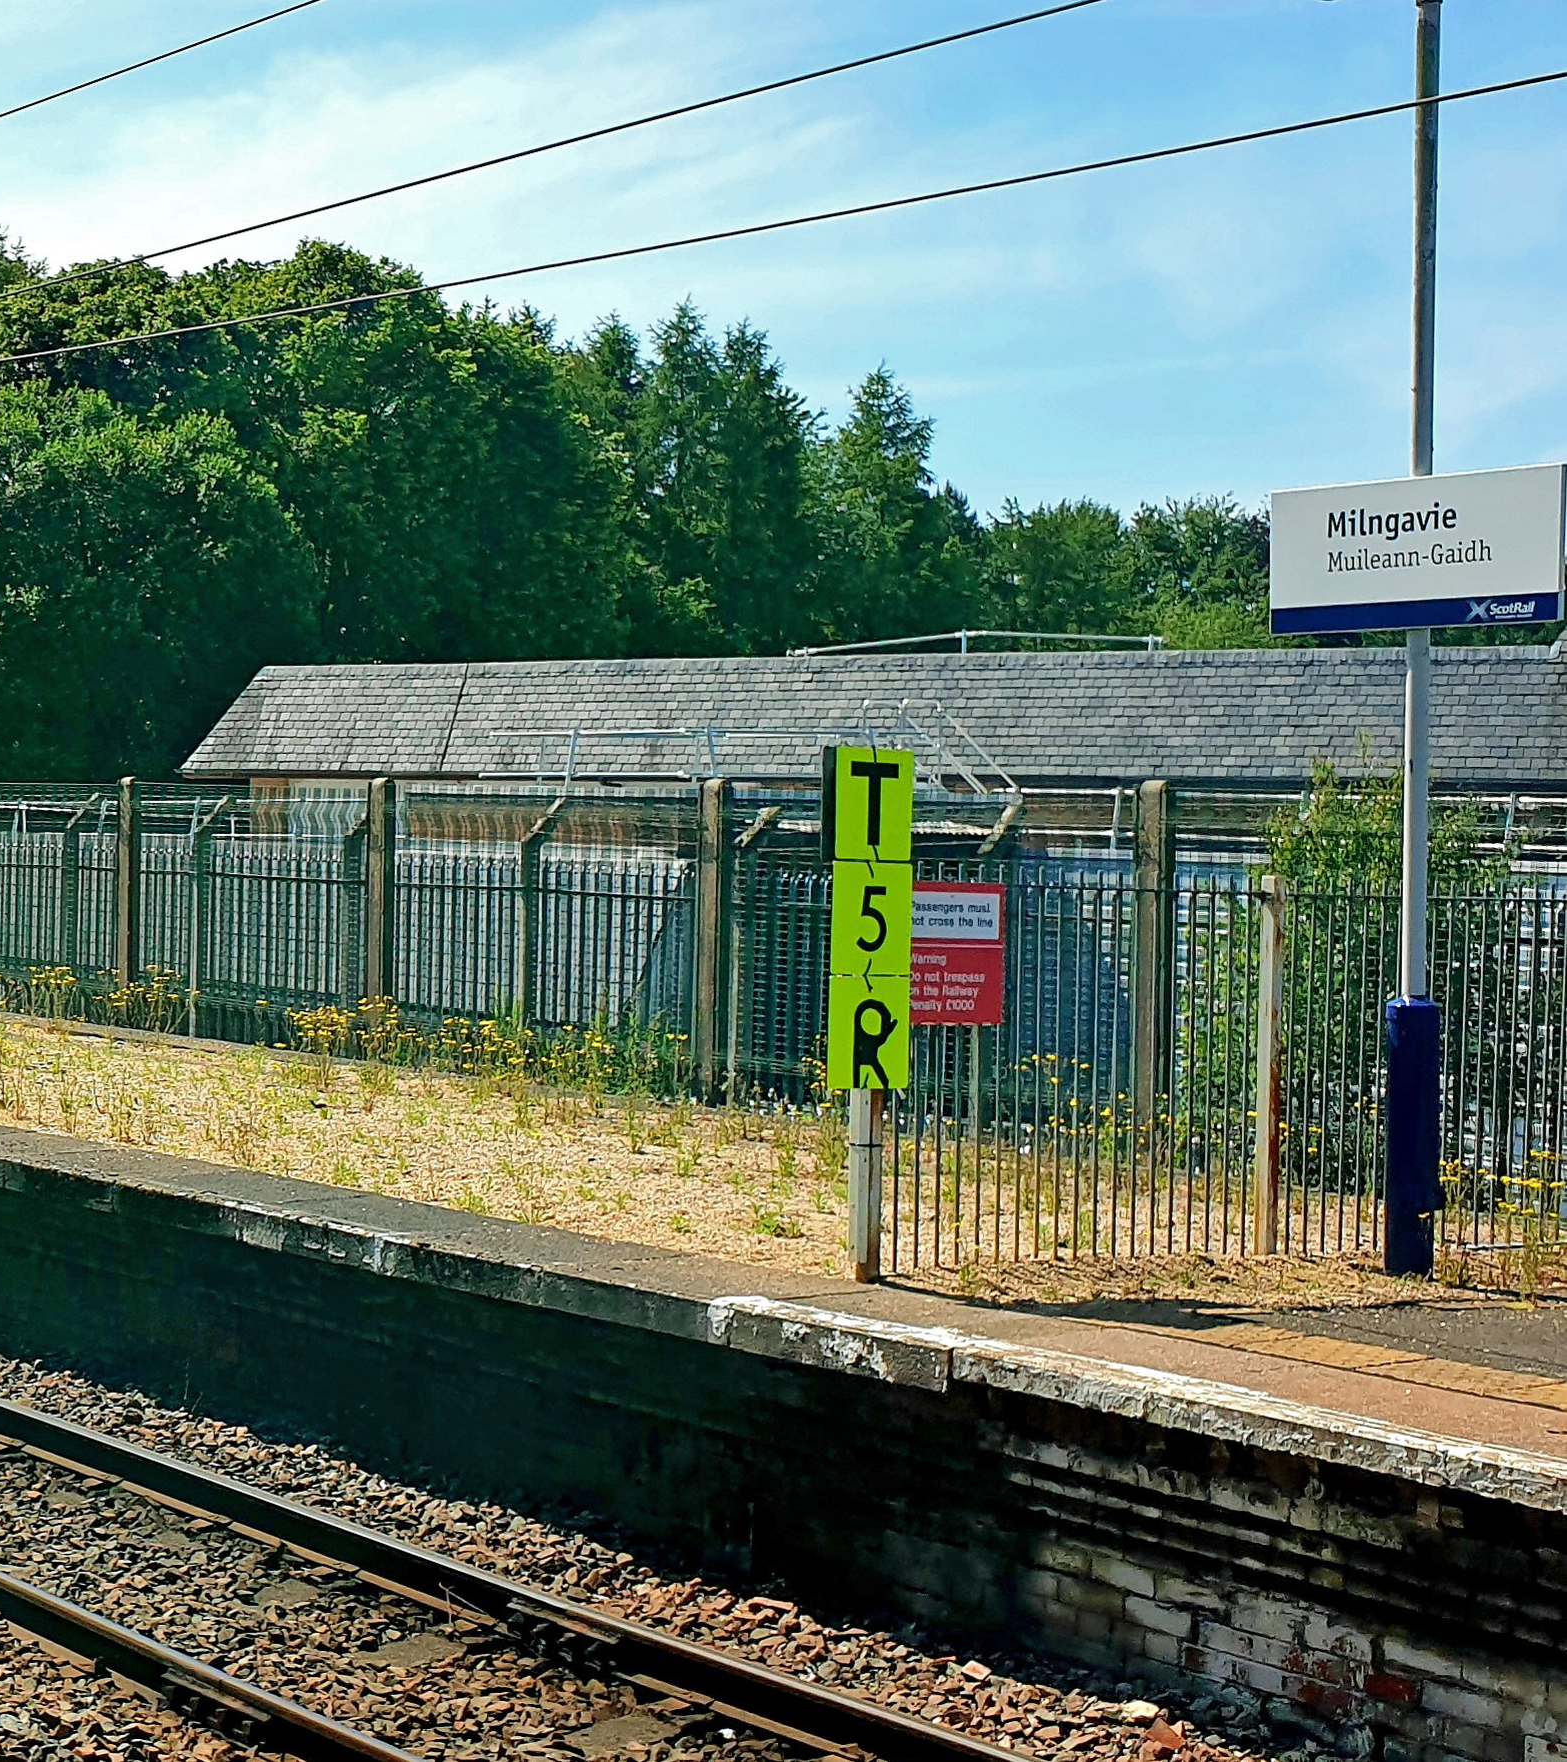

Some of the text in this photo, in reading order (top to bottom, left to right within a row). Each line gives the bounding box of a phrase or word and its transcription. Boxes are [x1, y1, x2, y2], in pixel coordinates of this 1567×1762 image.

[1327, 502, 1458, 540] Milngavie
[1327, 539, 1492, 573] Muileann-Gaidh
[1489, 600, 1535, 615] ScotRail
[850, 760, 900, 846] T
[856, 886, 888, 952] 5
[928, 917, 954, 927] cross
[958, 917, 973, 927] the
[977, 917, 993, 928] line
[923, 985, 939, 996] the
[942, 985, 979, 998] Railway
[924, 971, 940, 982] not
[944, 971, 985, 985] trespass
[853, 998, 898, 1090] R
